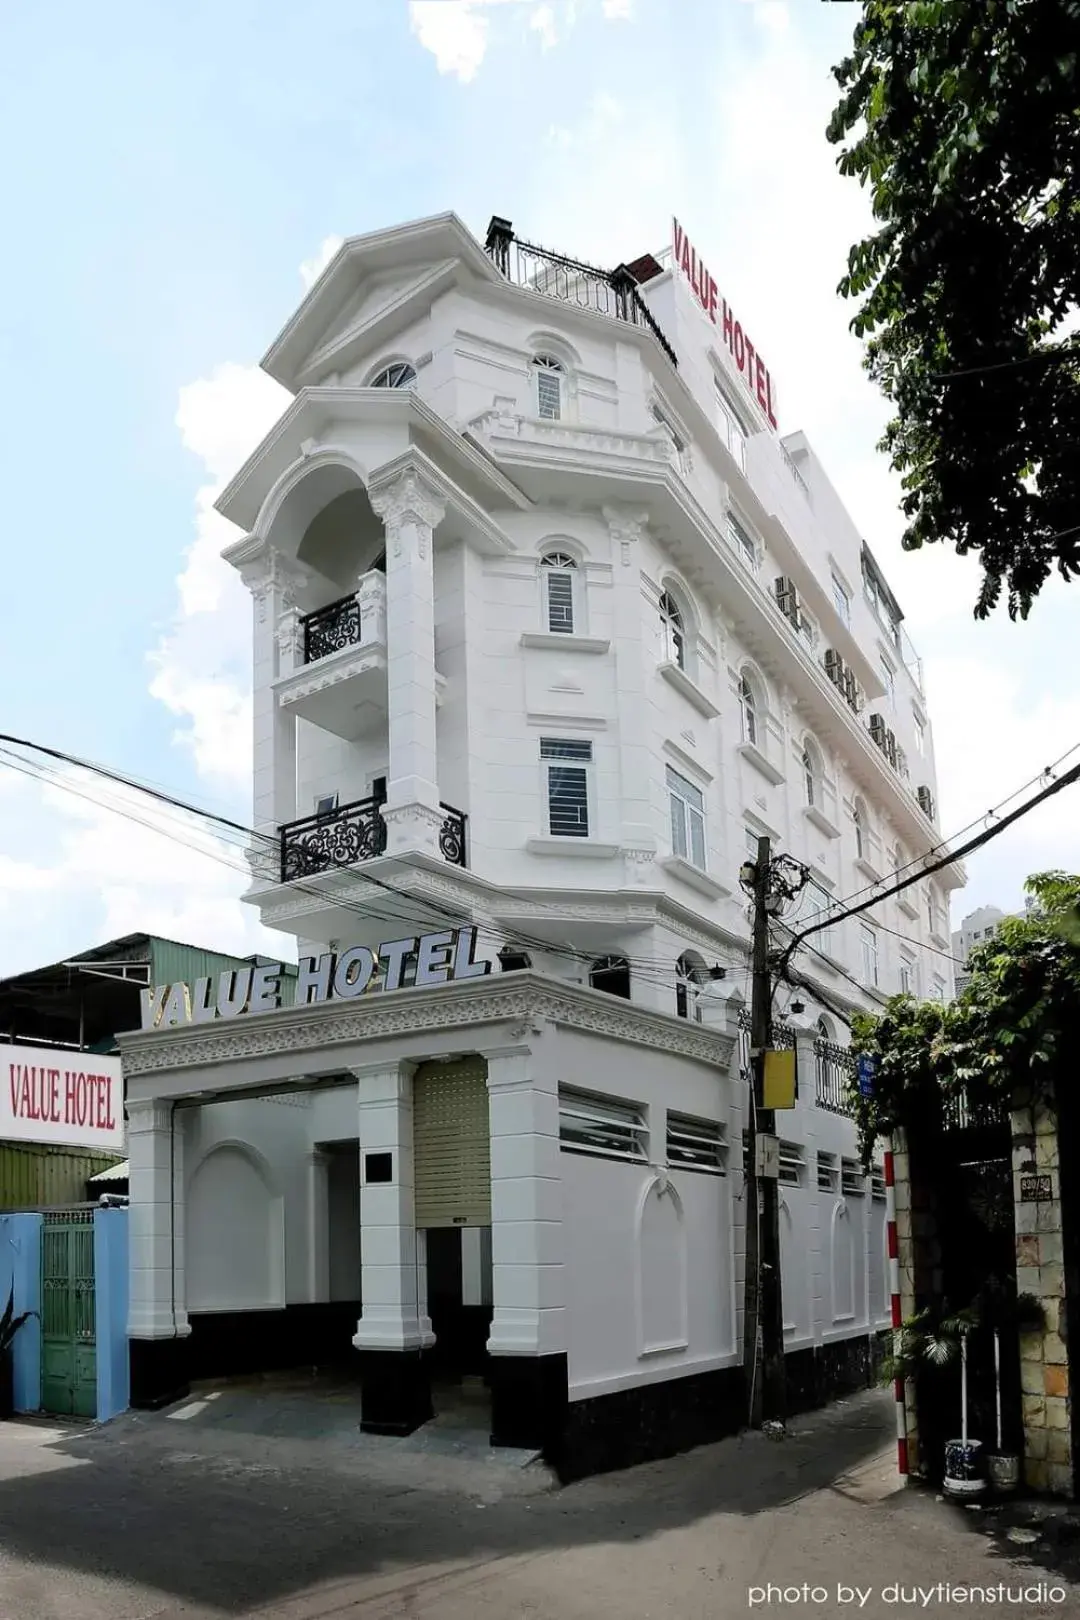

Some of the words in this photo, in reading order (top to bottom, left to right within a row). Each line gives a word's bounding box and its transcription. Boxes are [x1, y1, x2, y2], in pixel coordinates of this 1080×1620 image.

[672, 216, 718, 324] VALUE
[722, 298, 778, 430] HOTEL
[139, 963, 287, 1031] VALUE
[295, 926, 492, 1005] HOTEL
[9, 1064, 61, 1122] VALUE
[64, 1071, 116, 1130] HOTEL
